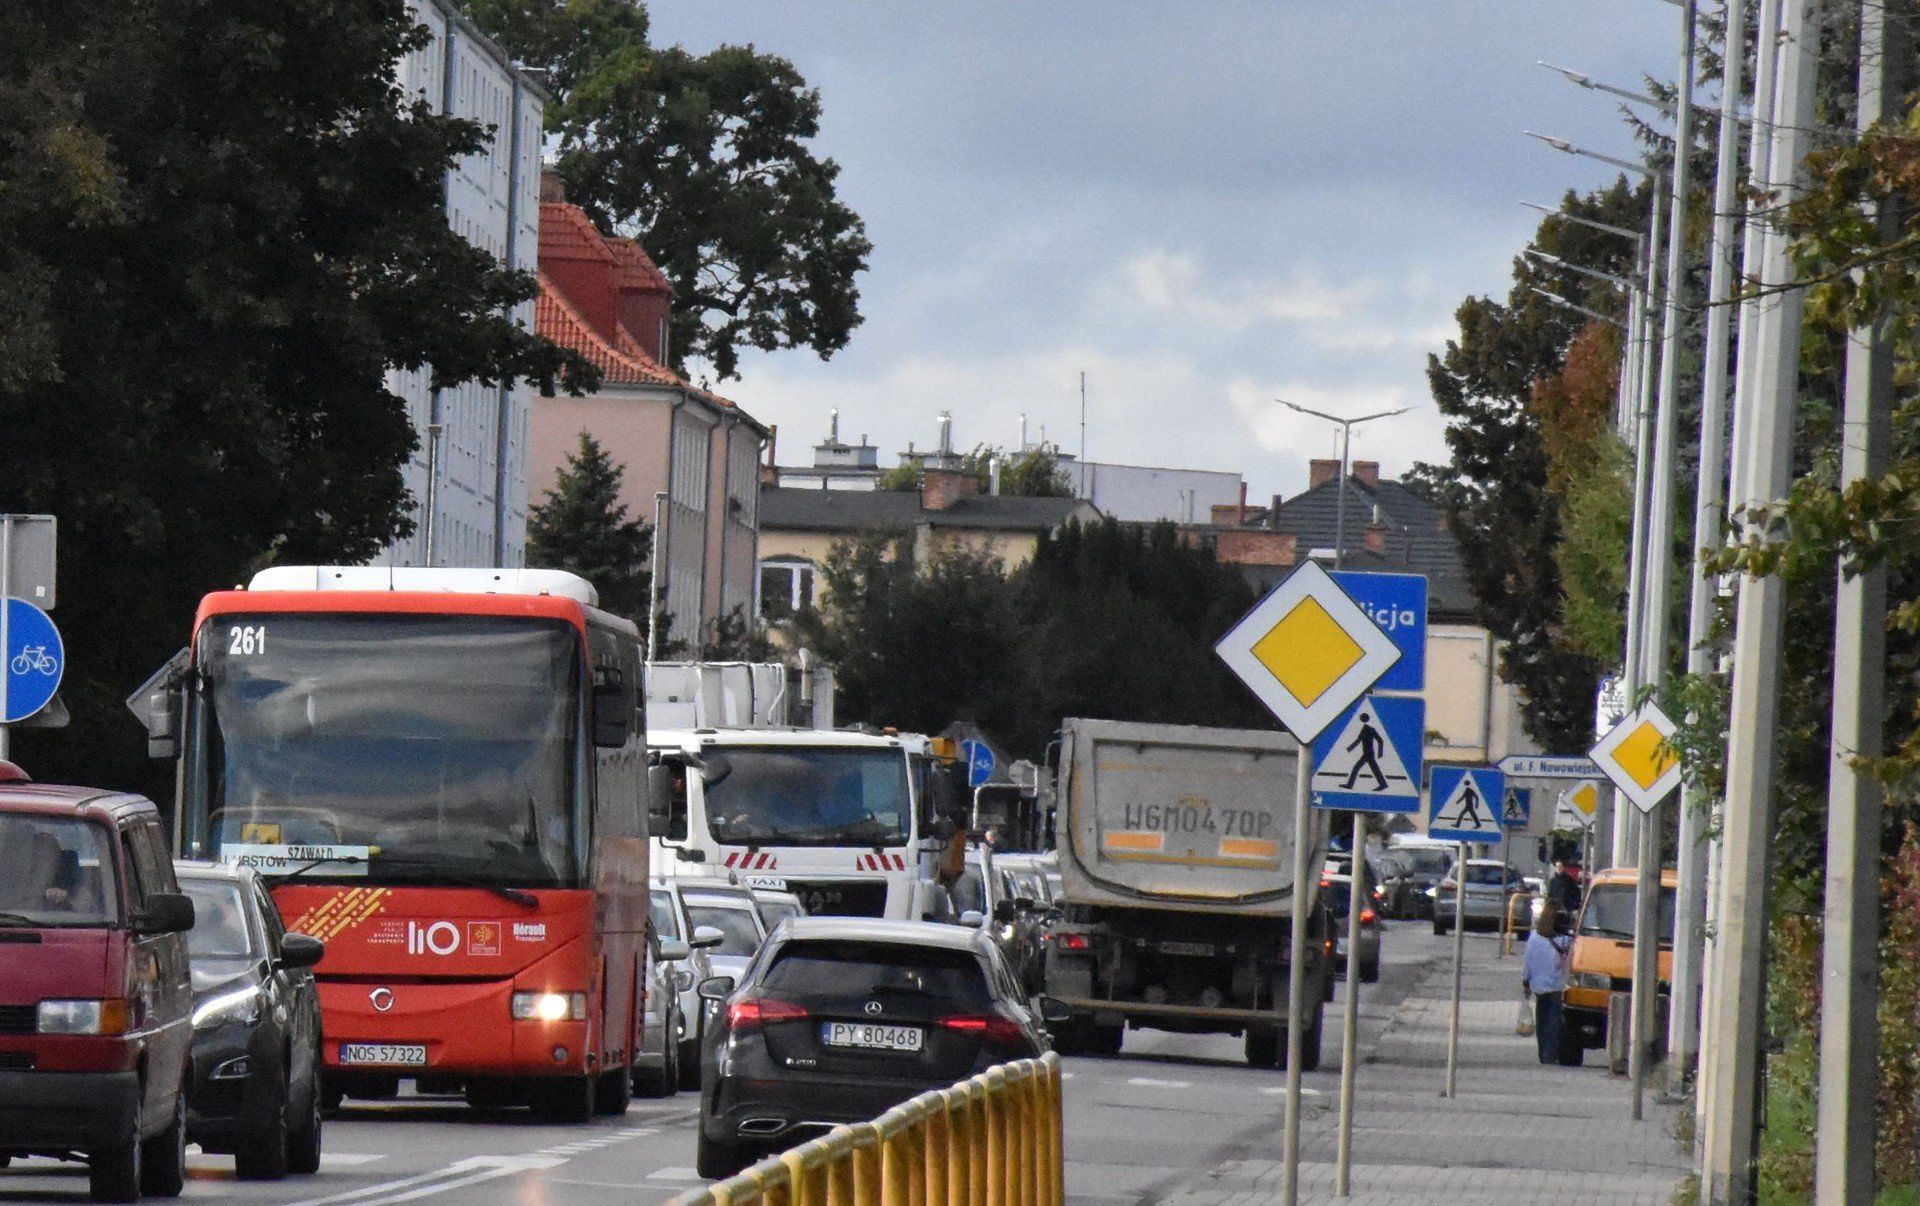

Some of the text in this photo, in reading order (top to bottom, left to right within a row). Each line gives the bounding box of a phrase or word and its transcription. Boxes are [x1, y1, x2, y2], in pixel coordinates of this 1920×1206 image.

[230, 626, 265, 655] 261
[1540, 761, 1602, 775] Nowowiejsk
[751, 878, 782, 887] TAXI
[834, 1024, 917, 1046] PY 80468
[348, 1046, 424, 1062] NOS 57322
